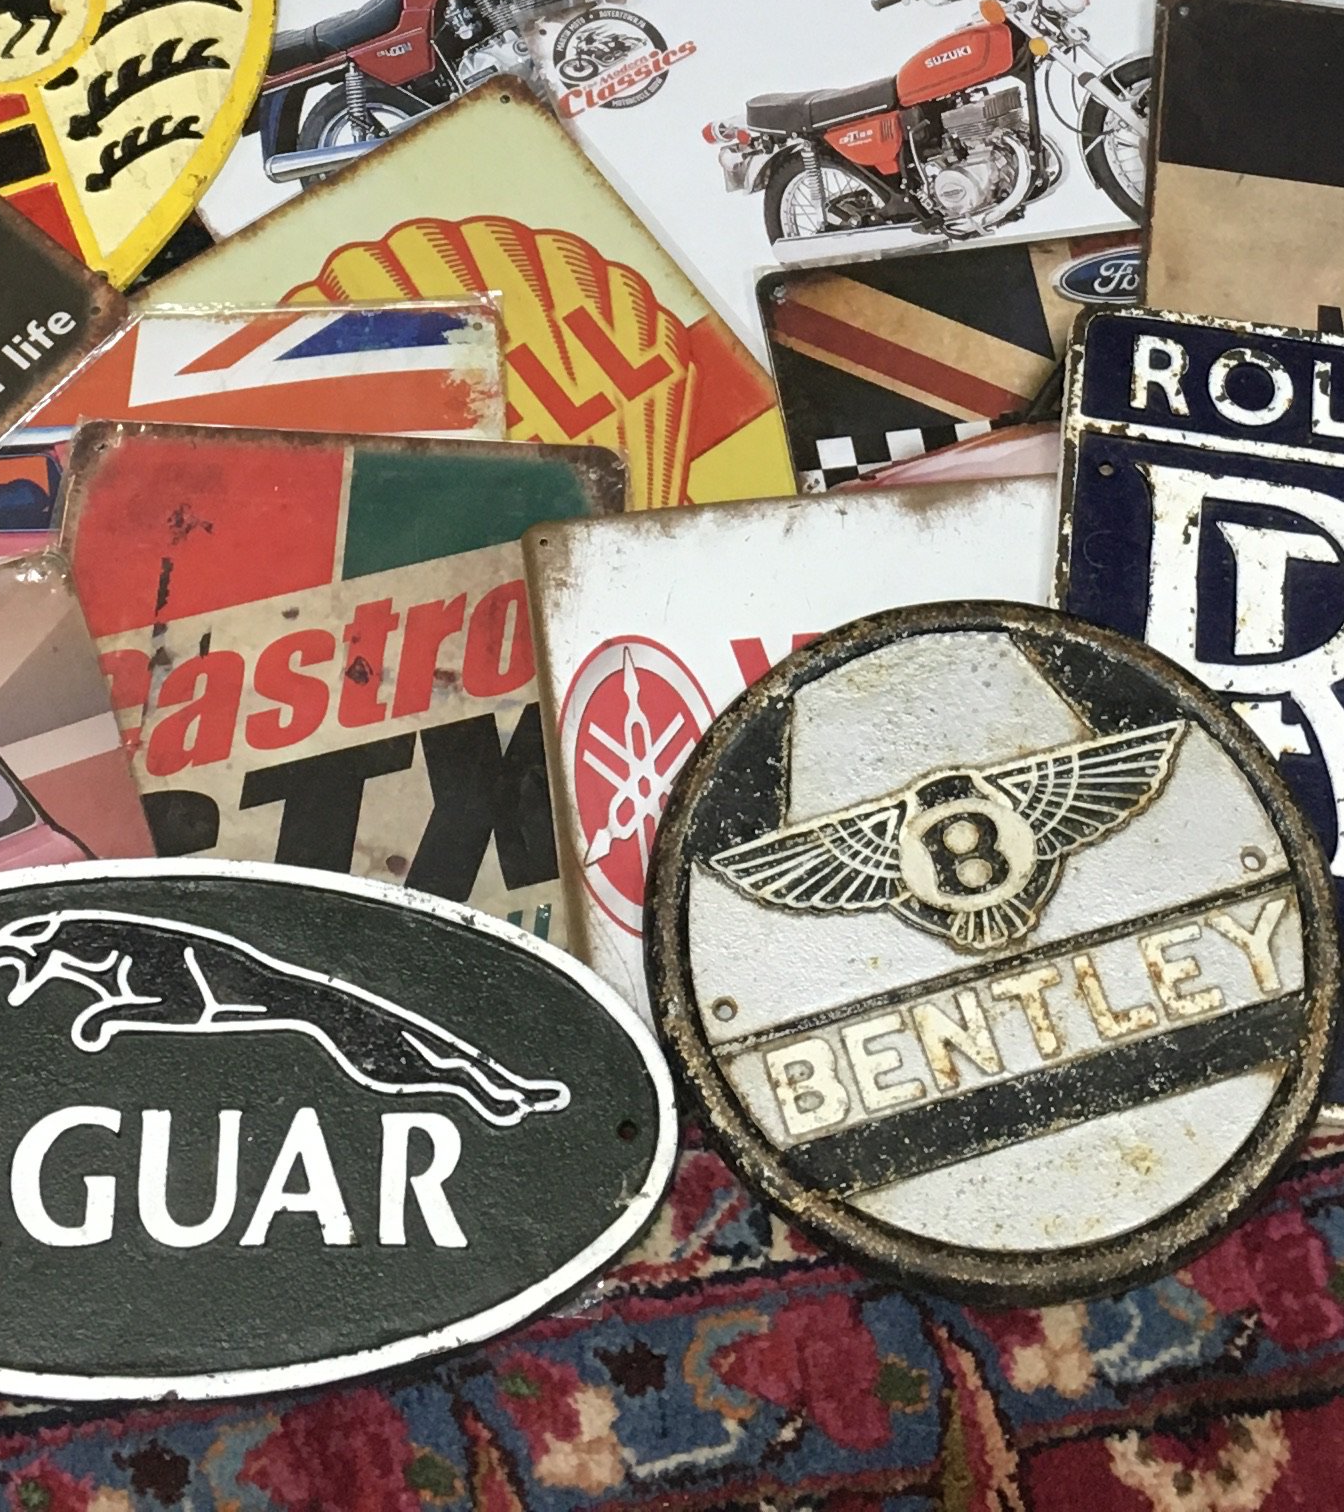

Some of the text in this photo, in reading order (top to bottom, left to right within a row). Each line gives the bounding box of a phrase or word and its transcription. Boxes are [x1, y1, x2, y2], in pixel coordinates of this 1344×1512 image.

[558, 40, 698, 120] Classics
[924, 45, 973, 69] SUZUKI
[0, 304, 77, 381] life
[764, 894, 1287, 1138] BENTLEY
